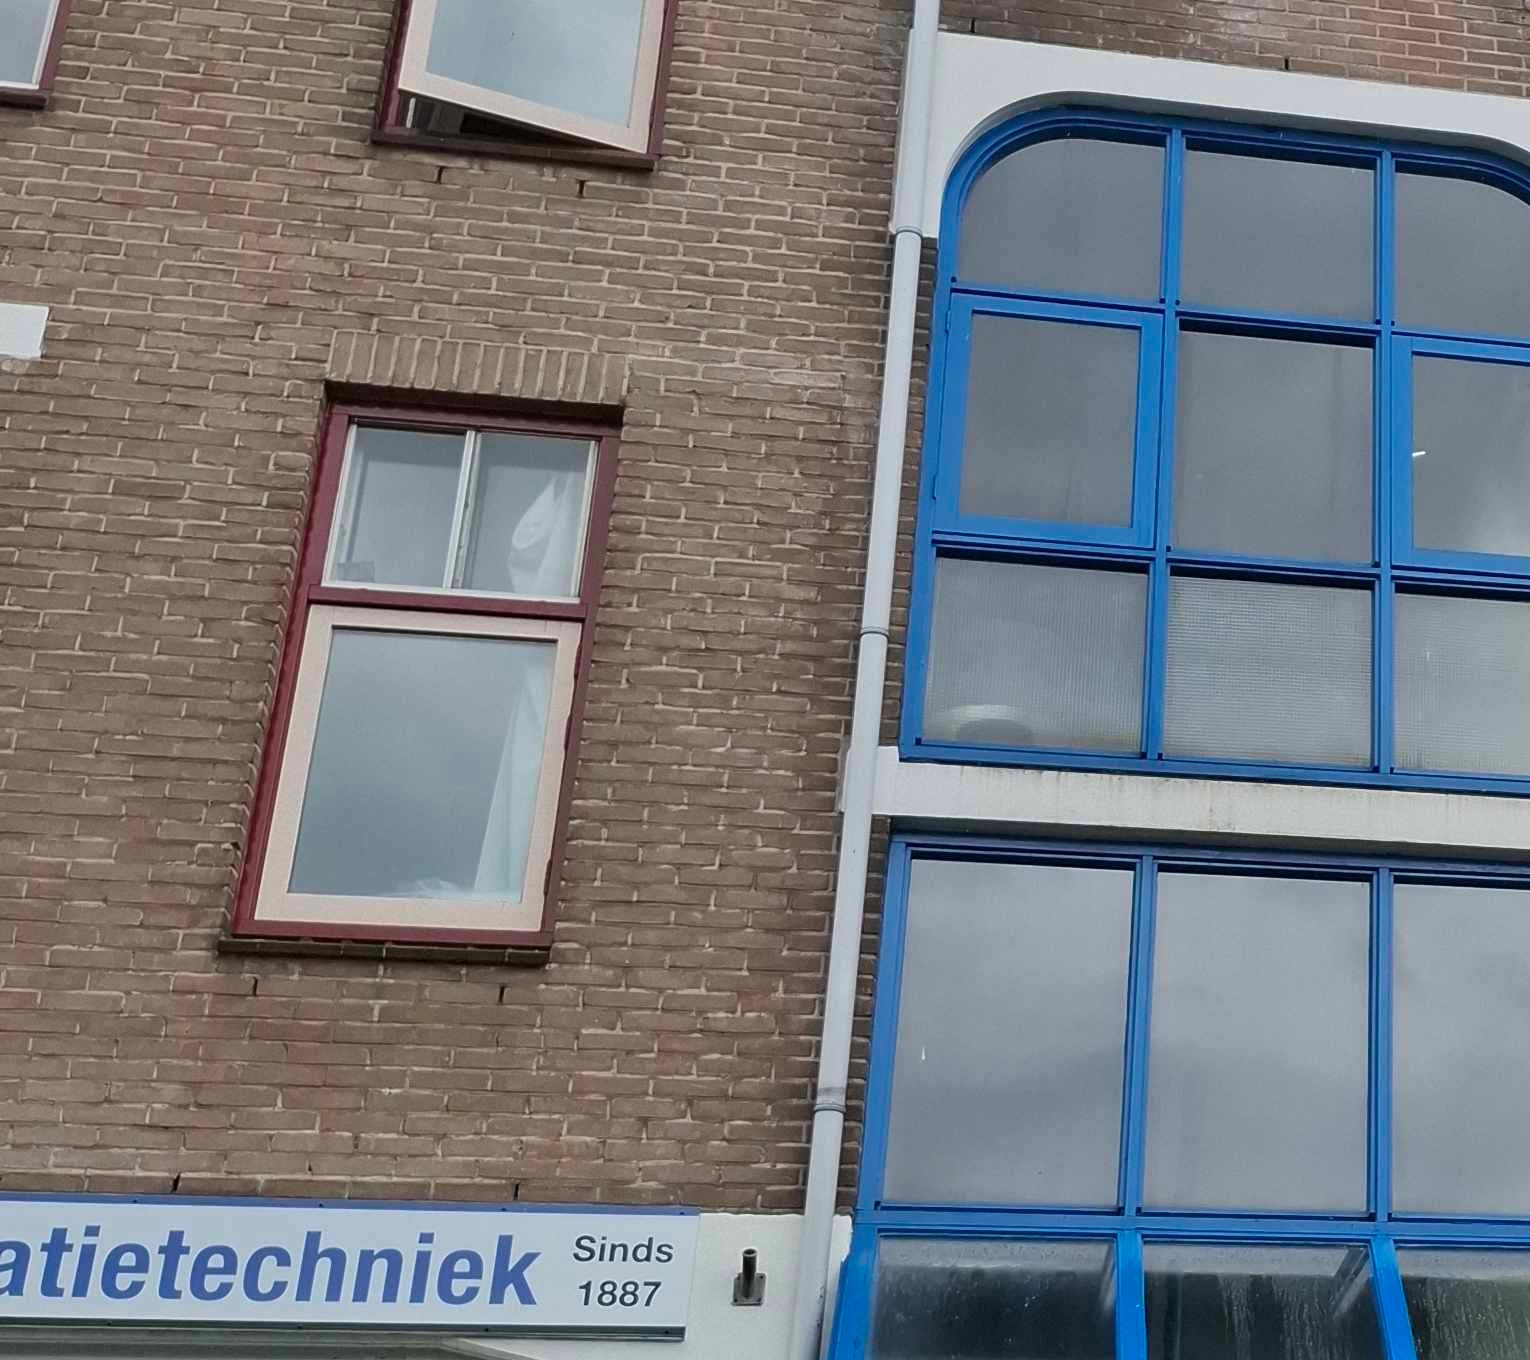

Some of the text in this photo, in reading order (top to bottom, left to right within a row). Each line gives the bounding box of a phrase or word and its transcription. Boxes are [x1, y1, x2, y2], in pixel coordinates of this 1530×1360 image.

[572, 1235, 674, 1264] Sinds
[0, 1225, 541, 1306] atietechniek
[576, 1281, 662, 1307] 1887
